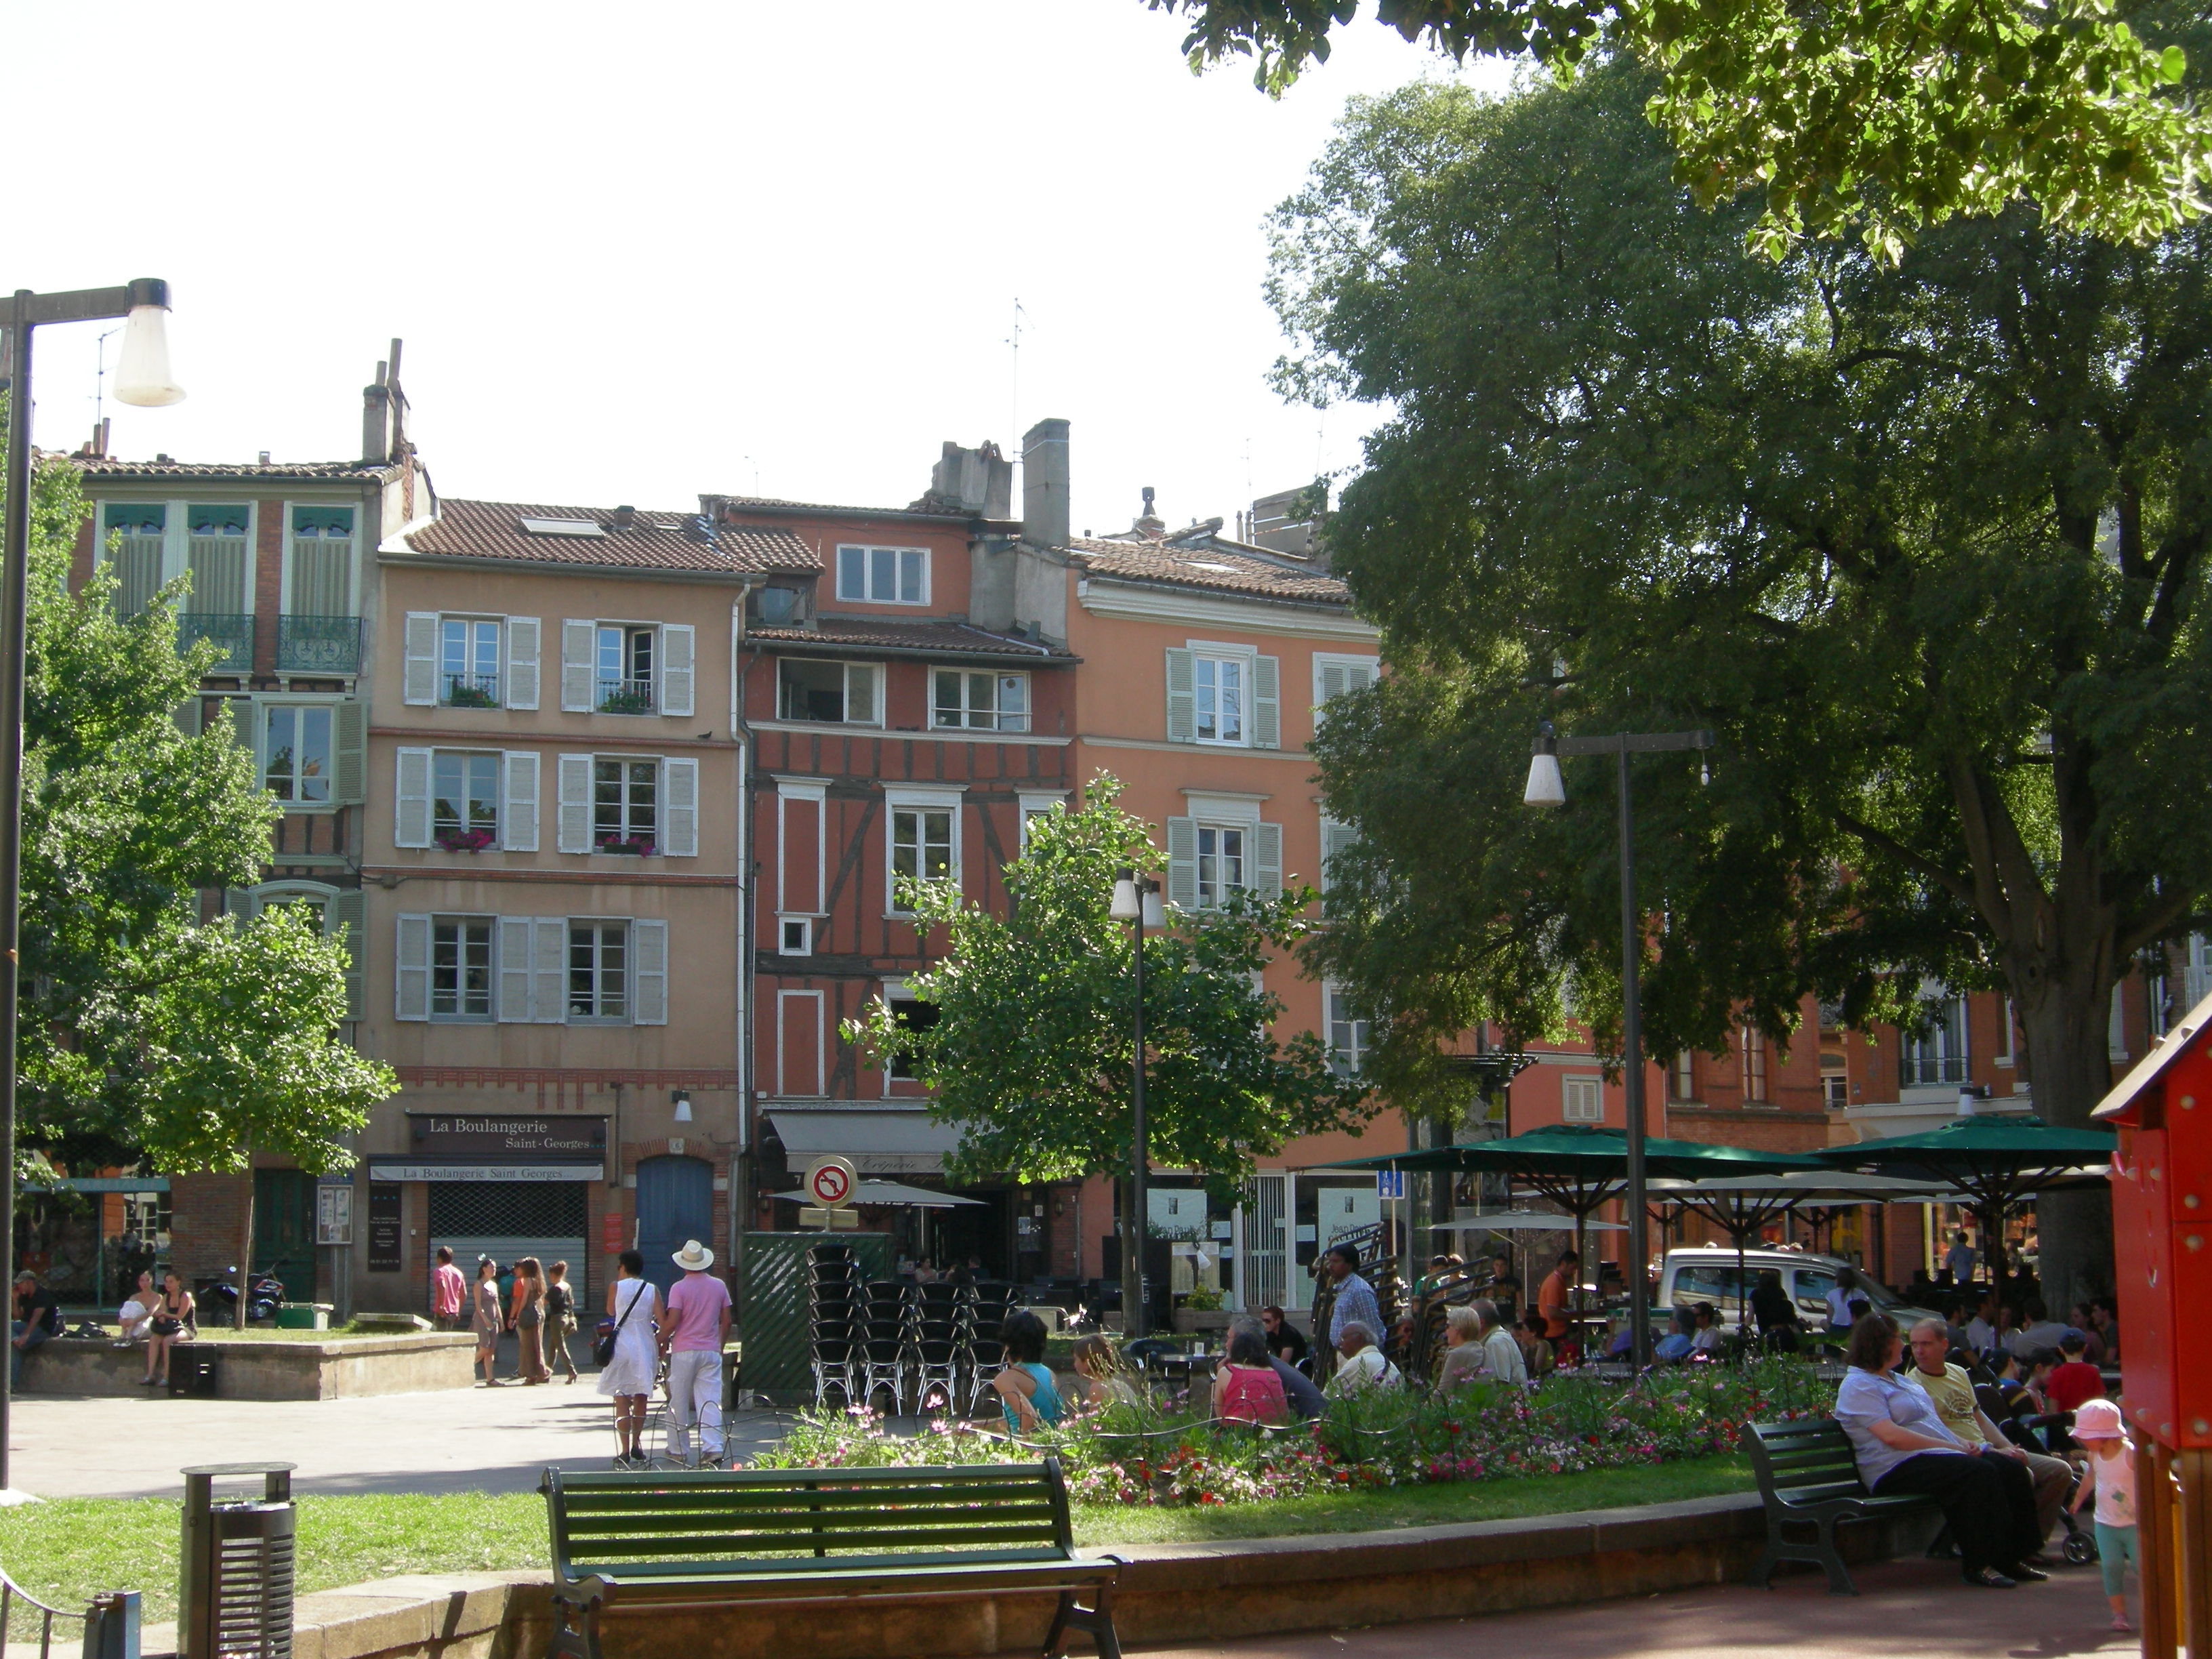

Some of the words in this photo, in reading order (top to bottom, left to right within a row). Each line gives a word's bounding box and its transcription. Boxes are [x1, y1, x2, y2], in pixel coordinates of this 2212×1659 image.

[429, 1119, 449, 1132] La
[455, 1119, 548, 1135] Boulangerie
[404, 1168, 417, 1178] La
[424, 1168, 485, 1181] Boulangerie
[491, 1168, 516, 1179] Saint
[794, 1175, 801, 1185] 7
[1332, 1224, 1348, 1233] Jean
